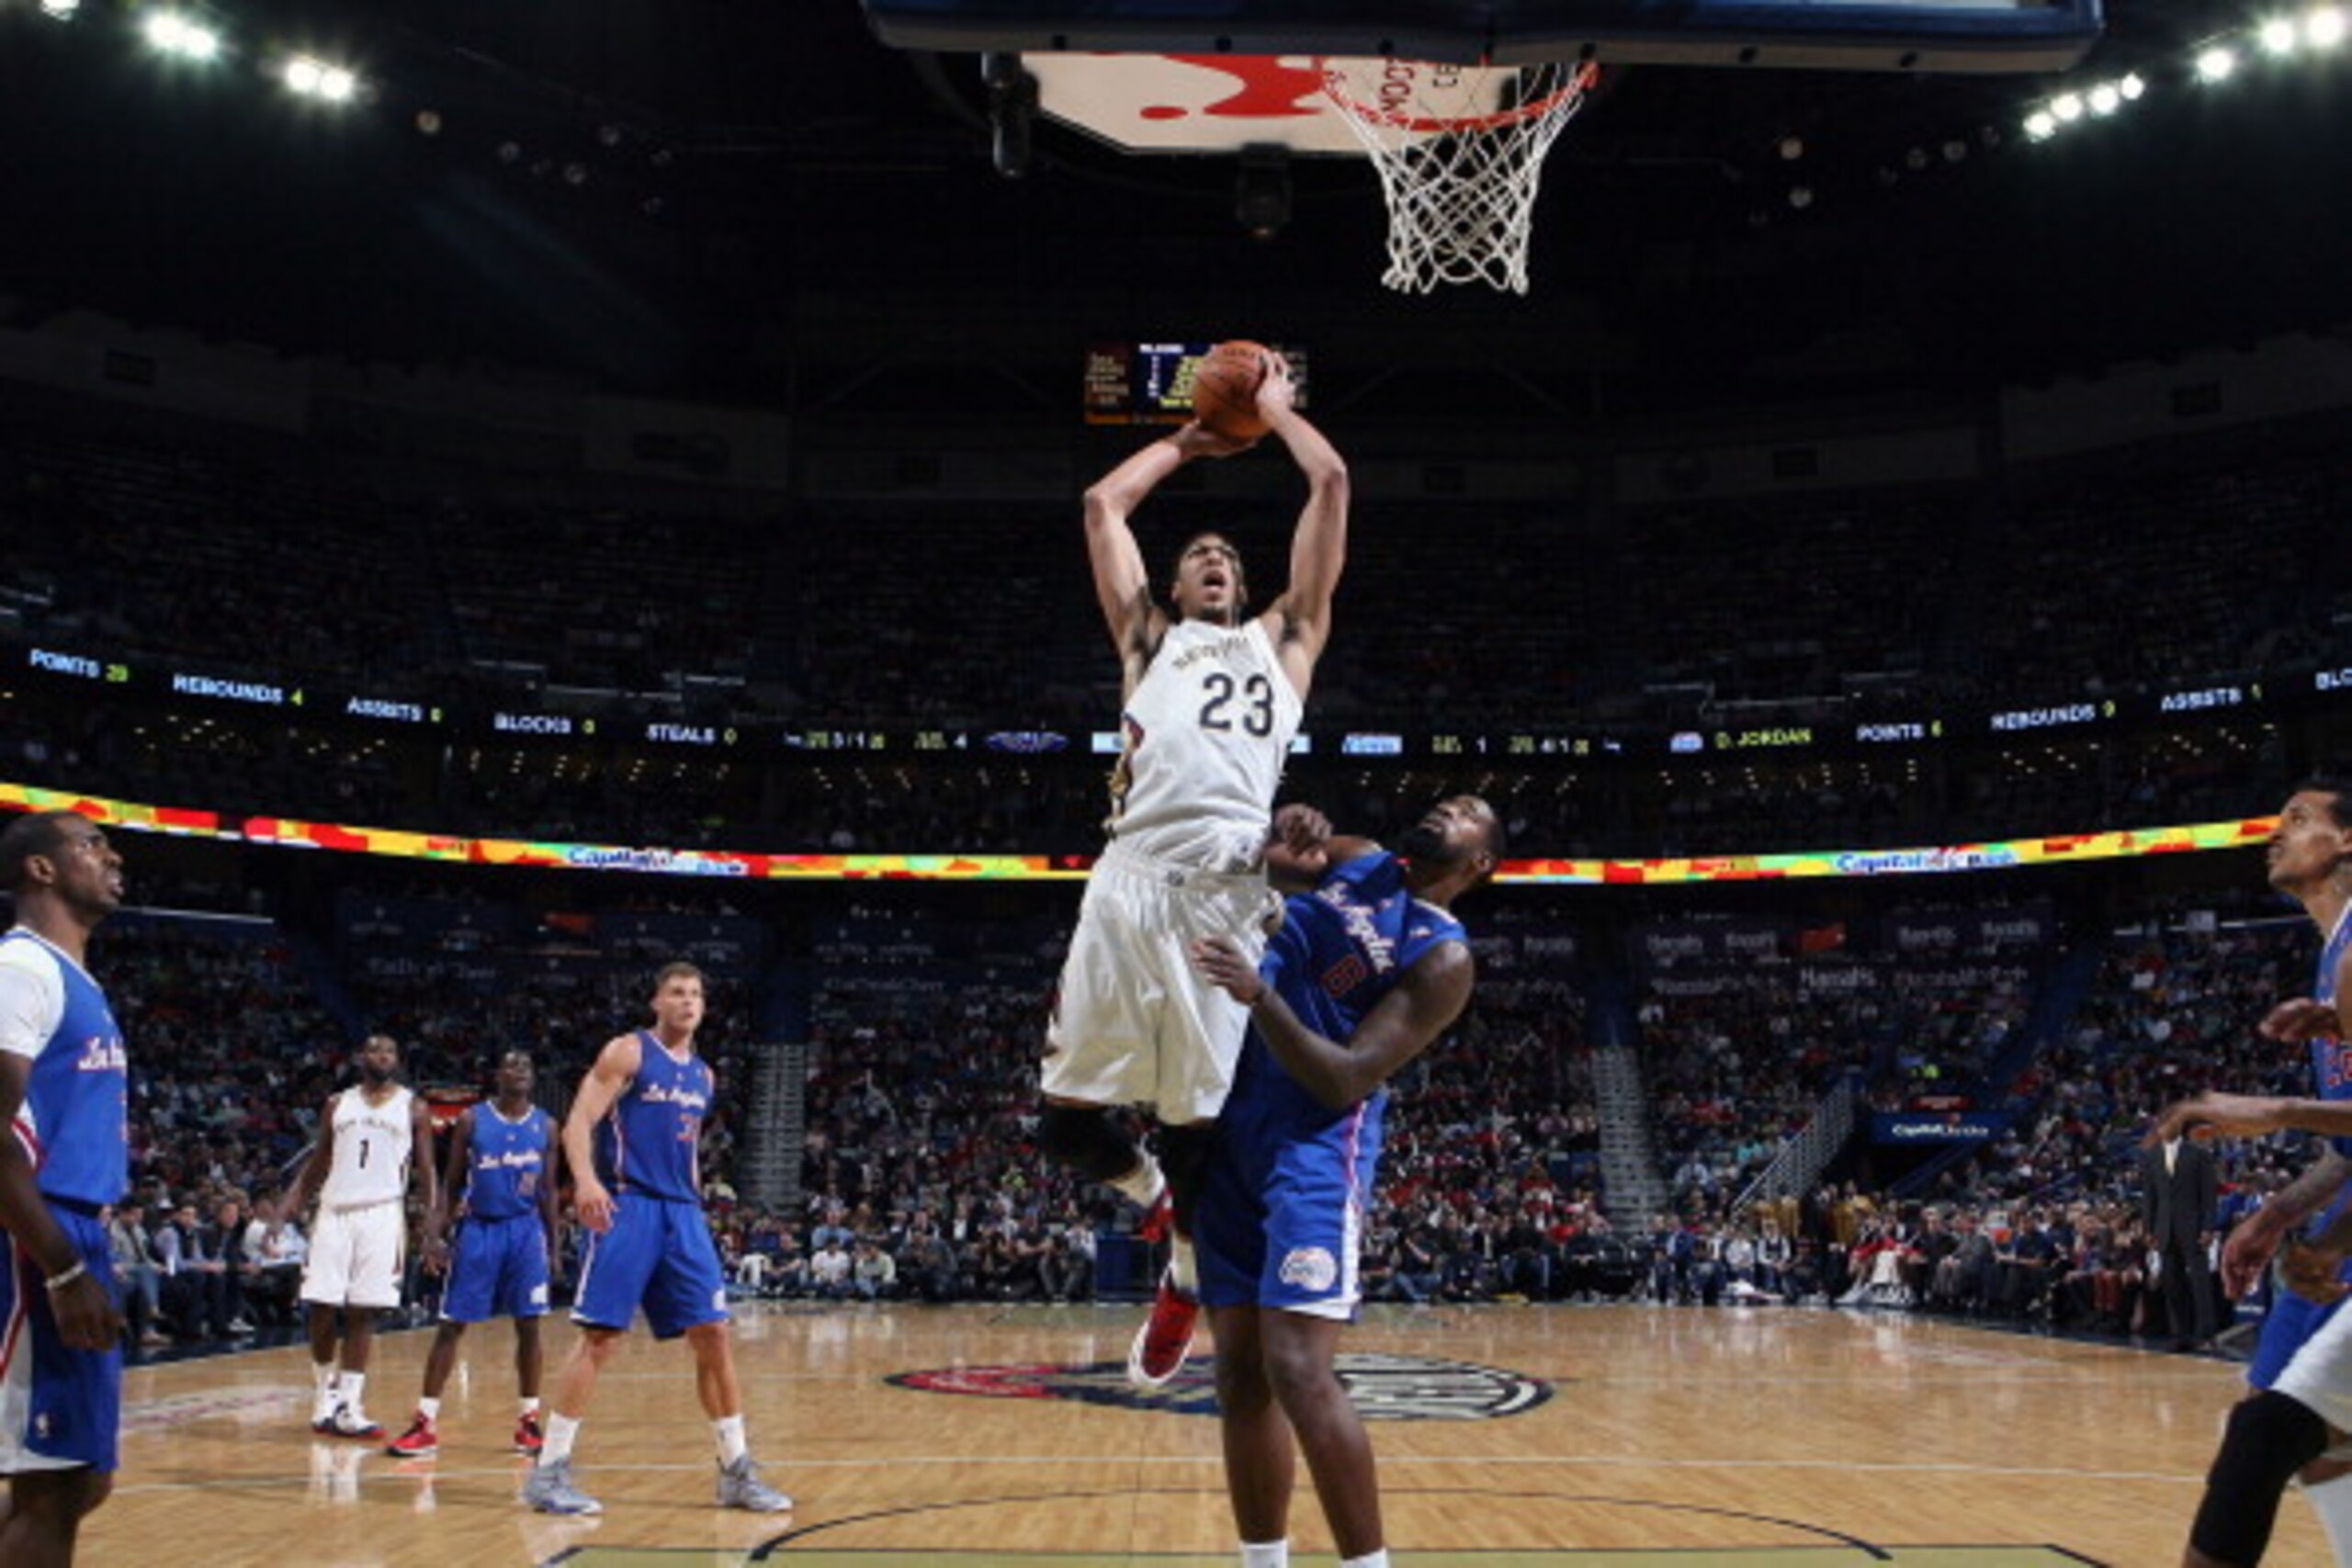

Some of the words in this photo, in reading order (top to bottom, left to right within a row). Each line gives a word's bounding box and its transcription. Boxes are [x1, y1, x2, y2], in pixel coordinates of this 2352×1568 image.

[30, 649, 100, 678] POINTS
[174, 674, 283, 704] REBOUNDS
[290, 689, 302, 705] 4
[2161, 687, 2242, 712] ASSISTS
[347, 697, 423, 722] ASSISTS
[1199, 671, 1274, 738] 23
[494, 713, 571, 734] BLOCKS
[1991, 704, 2096, 731] REBOUNDS
[647, 724, 715, 744] STEALS
[1736, 728, 1813, 746] JORDAN
[1857, 723, 1925, 741] POINTS
[358, 1138, 369, 1169] 1
